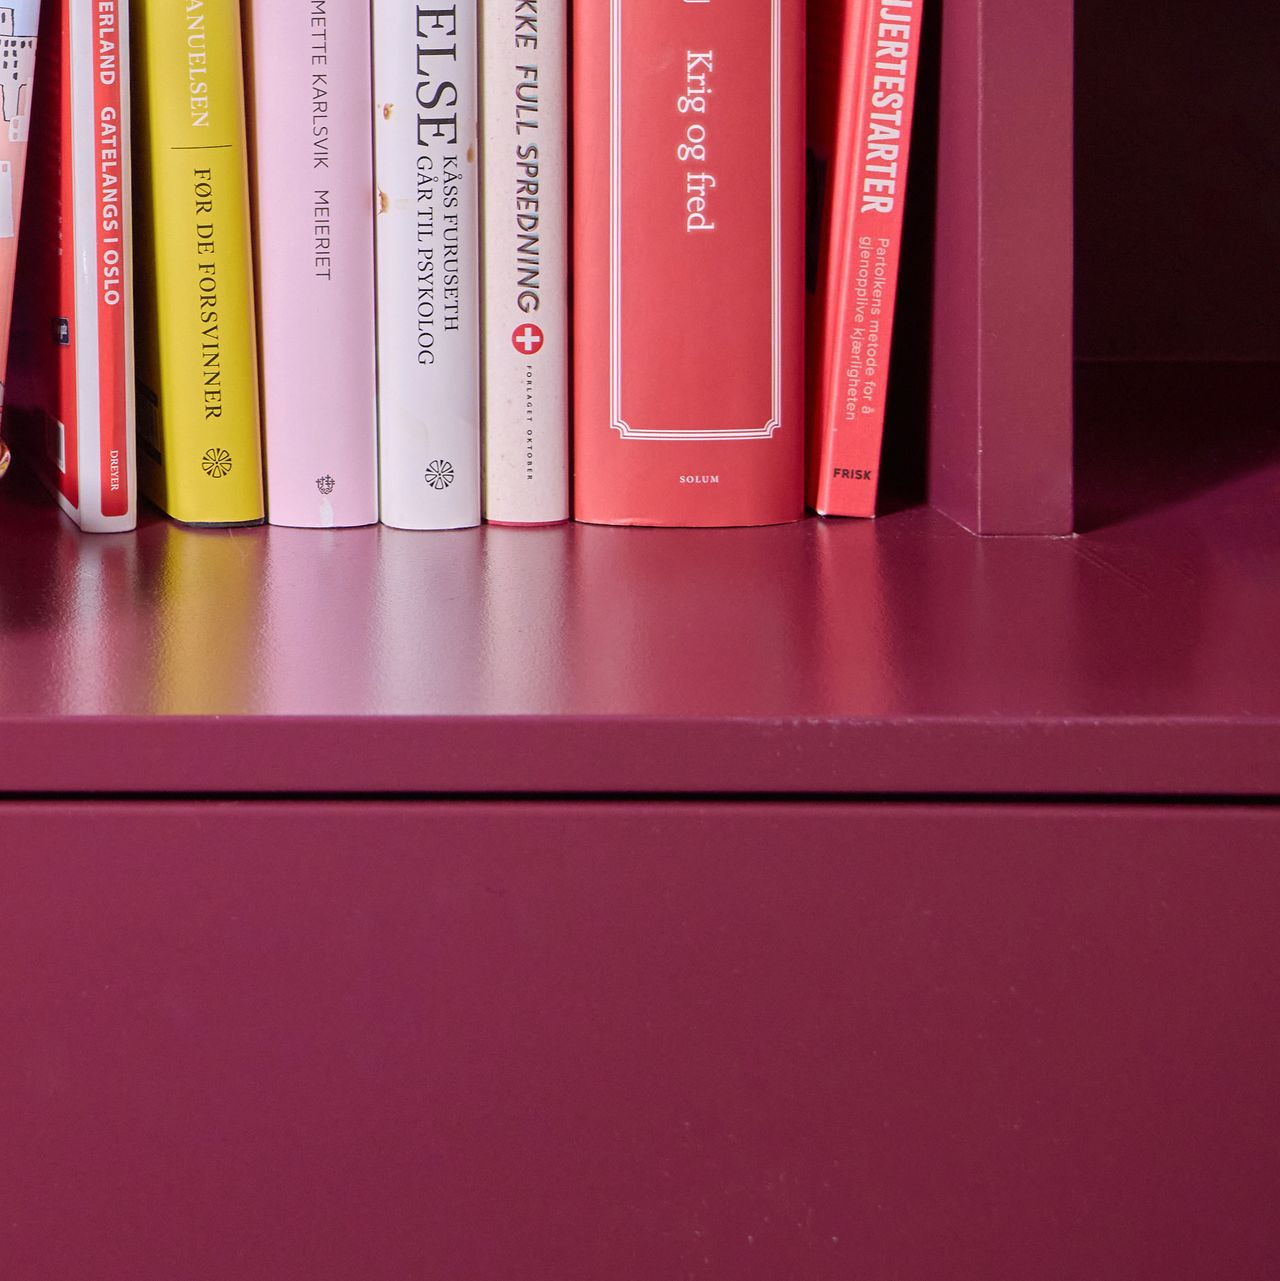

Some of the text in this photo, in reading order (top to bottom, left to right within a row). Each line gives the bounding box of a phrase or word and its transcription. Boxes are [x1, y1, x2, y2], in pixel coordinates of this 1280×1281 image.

[416, 4, 458, 147] ELSE
[515, 64, 539, 136] FULL
[677, 50, 713, 113] Krig
[100, 107, 119, 231] GATELANGS
[311, 0, 331, 280] METTE KARLSVIK MEIERIET
[676, 124, 706, 162] og
[686, 172, 716, 232] fred
[103, 250, 120, 306] OSLO
[416, 155, 438, 365] GÅR TIL PSYKOLOG
[442, 155, 463, 332] KÅSS FURUSETH
[516, 144, 540, 314] SPREDNING
[194, 168, 223, 420] FØR DE FORSVINNER
[845, 236, 871, 422] gjenopplive kjærligheten
[861, 237, 890, 415] Partolkens metode for å
[109, 450, 119, 491] DREYER
[679, 475, 720, 484] SOLUM
[833, 468, 872, 481] FRISK
